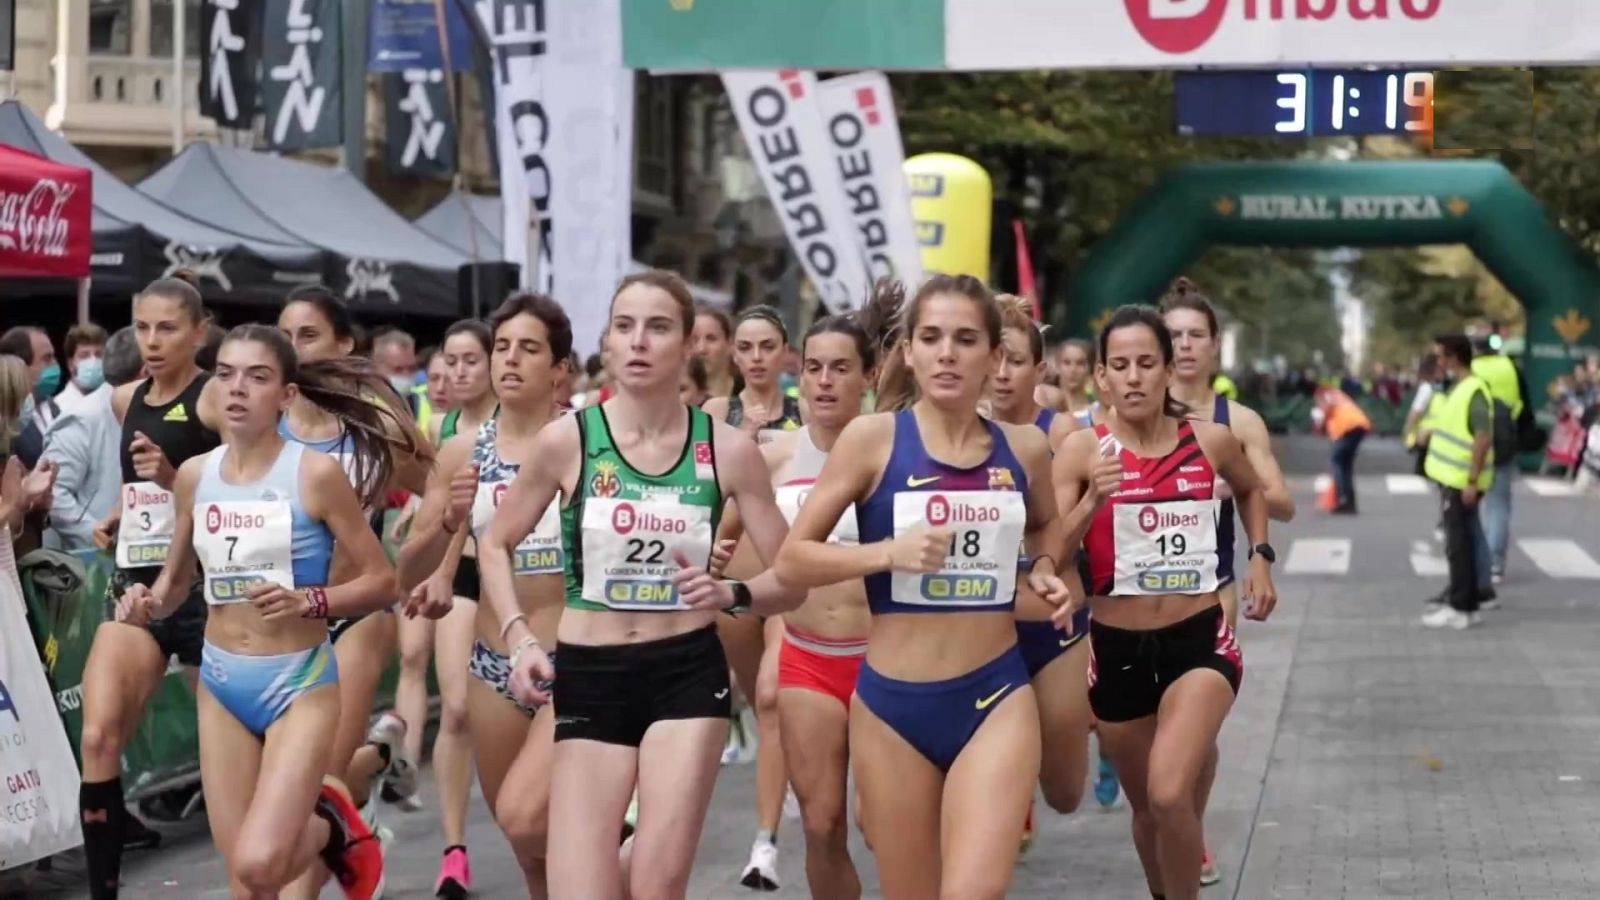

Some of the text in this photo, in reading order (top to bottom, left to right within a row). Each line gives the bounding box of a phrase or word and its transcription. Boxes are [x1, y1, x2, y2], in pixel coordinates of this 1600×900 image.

[1275, 72, 1434, 132] 31:19
[1240, 194, 1443, 219] RURAL KUTXA
[127, 486, 169, 510] Bilbao
[626, 483, 685, 494] VILLAEAL
[140, 511, 151, 531] 3
[206, 504, 265, 534] Bilbao
[612, 503, 686, 534] Bilbao
[926, 494, 1000, 526] Bilbao
[1139, 506, 1199, 533] Bilbao
[225, 536, 239, 561] 7
[625, 538, 665, 564] 22
[951, 530, 981, 557] 18
[1155, 533, 1187, 556] 19
[527, 551, 557, 567] BM
[604, 567, 645, 576] LORENA
[1166, 574, 1197, 589] BM
[637, 584, 673, 601] BM
[955, 579, 992, 597] BM
